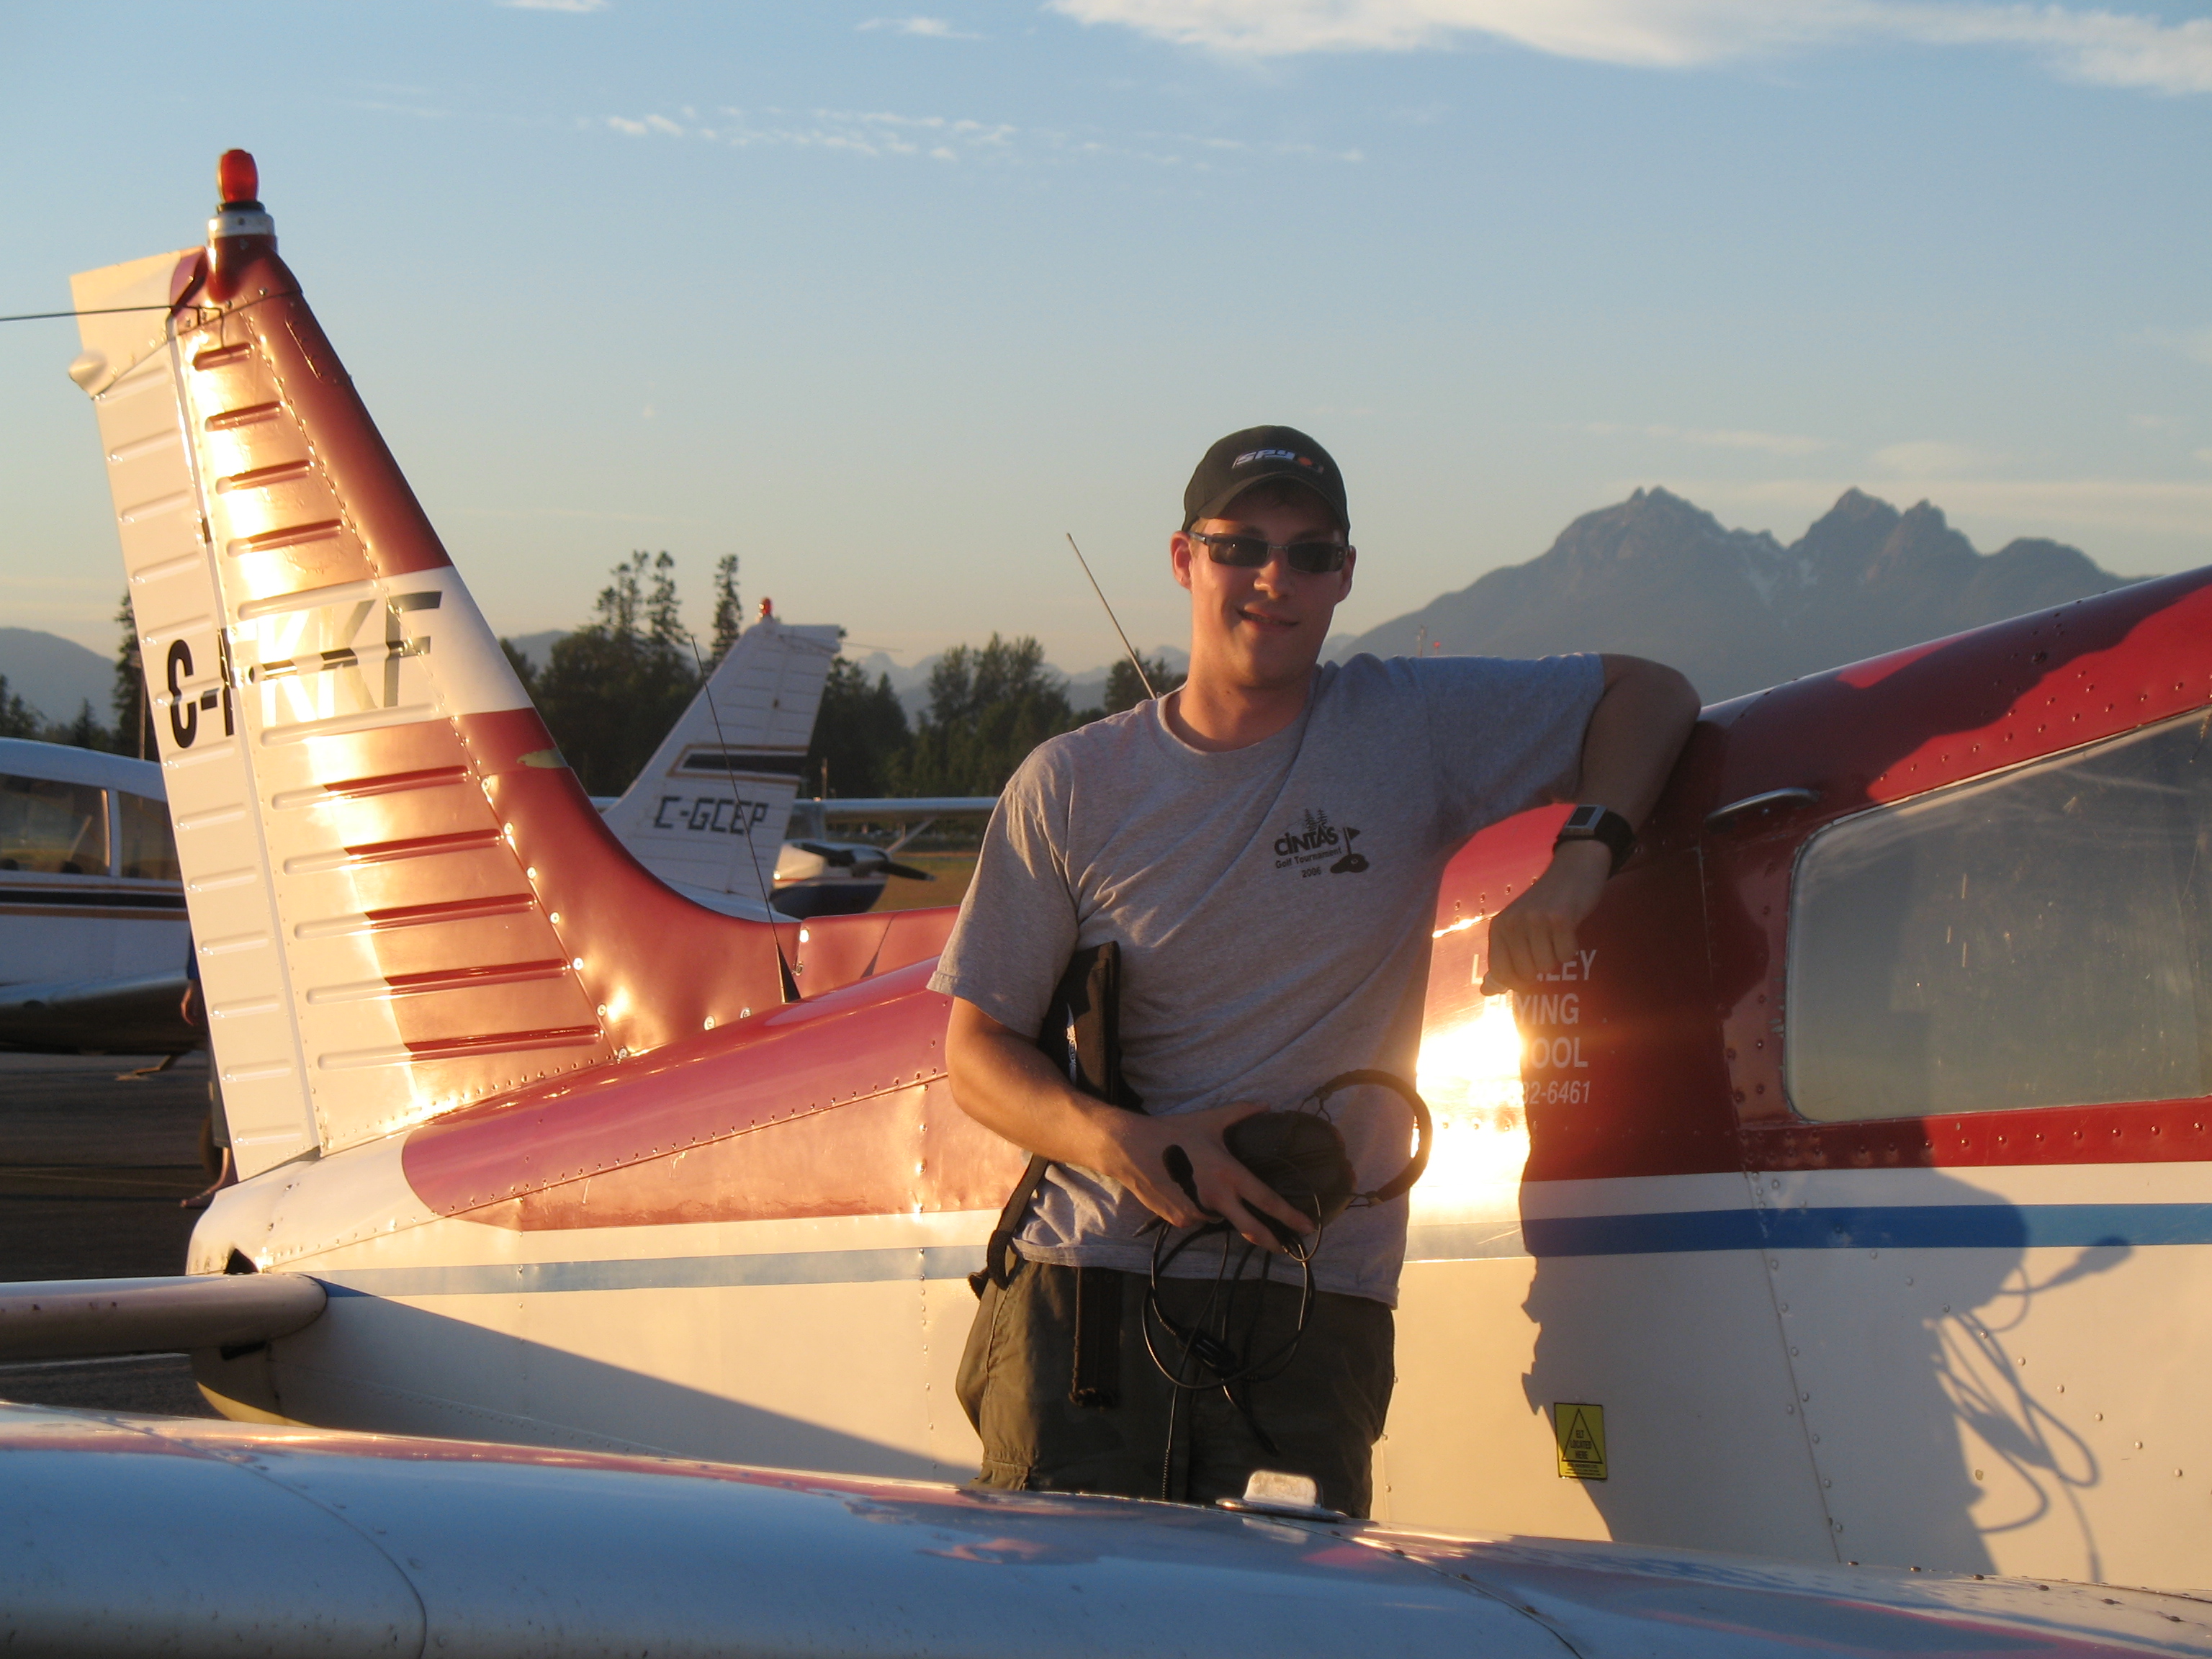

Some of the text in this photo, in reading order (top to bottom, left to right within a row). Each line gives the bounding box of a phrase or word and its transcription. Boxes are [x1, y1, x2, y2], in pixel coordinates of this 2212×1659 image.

[654, 796, 768, 835] C-GCEP
[1275, 847, 1342, 869] Golf Tournament
[1570, 1440, 1592, 1449] LOCATED
